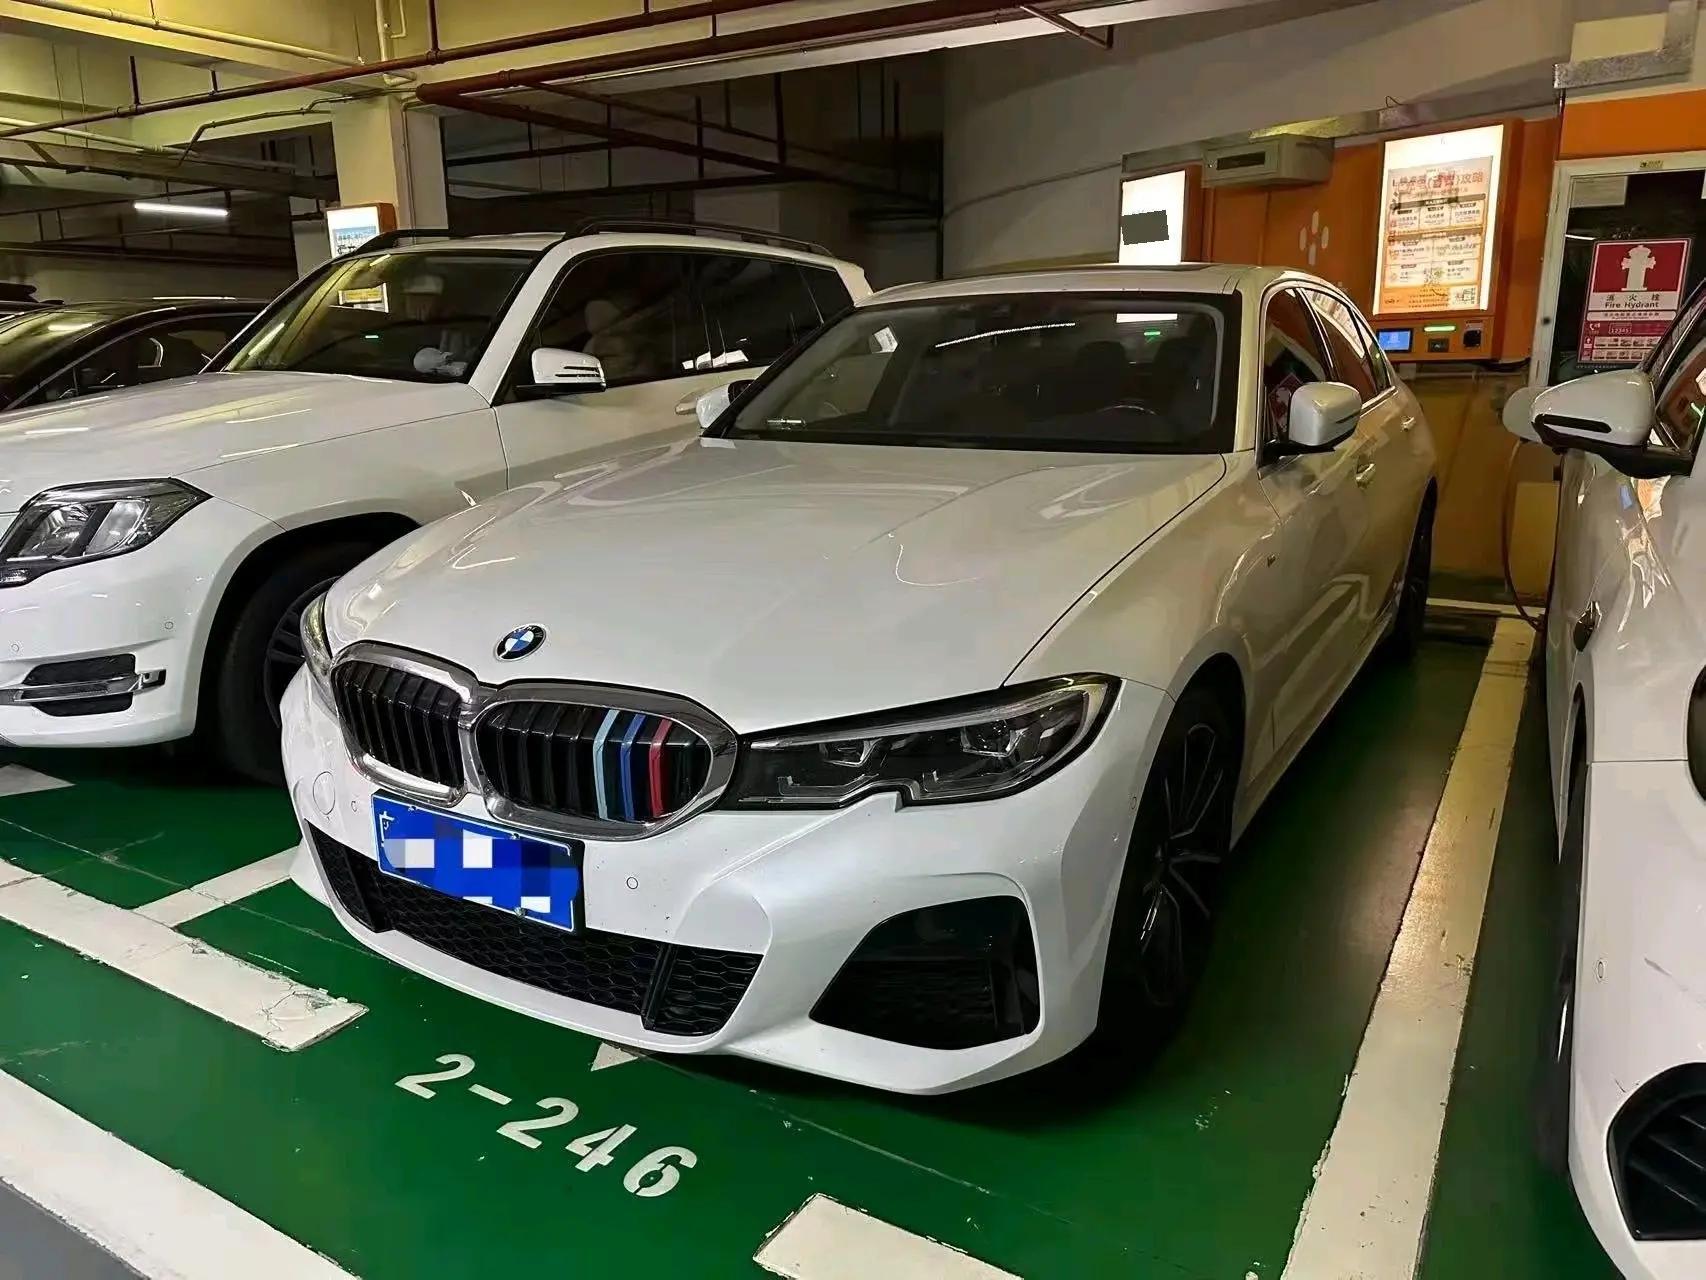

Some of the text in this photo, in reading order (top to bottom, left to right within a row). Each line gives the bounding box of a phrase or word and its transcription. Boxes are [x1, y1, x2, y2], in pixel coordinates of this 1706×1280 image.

[1605, 301, 1659, 310] Fire Hydrant
[395, 1054, 698, 1197] 2-246
